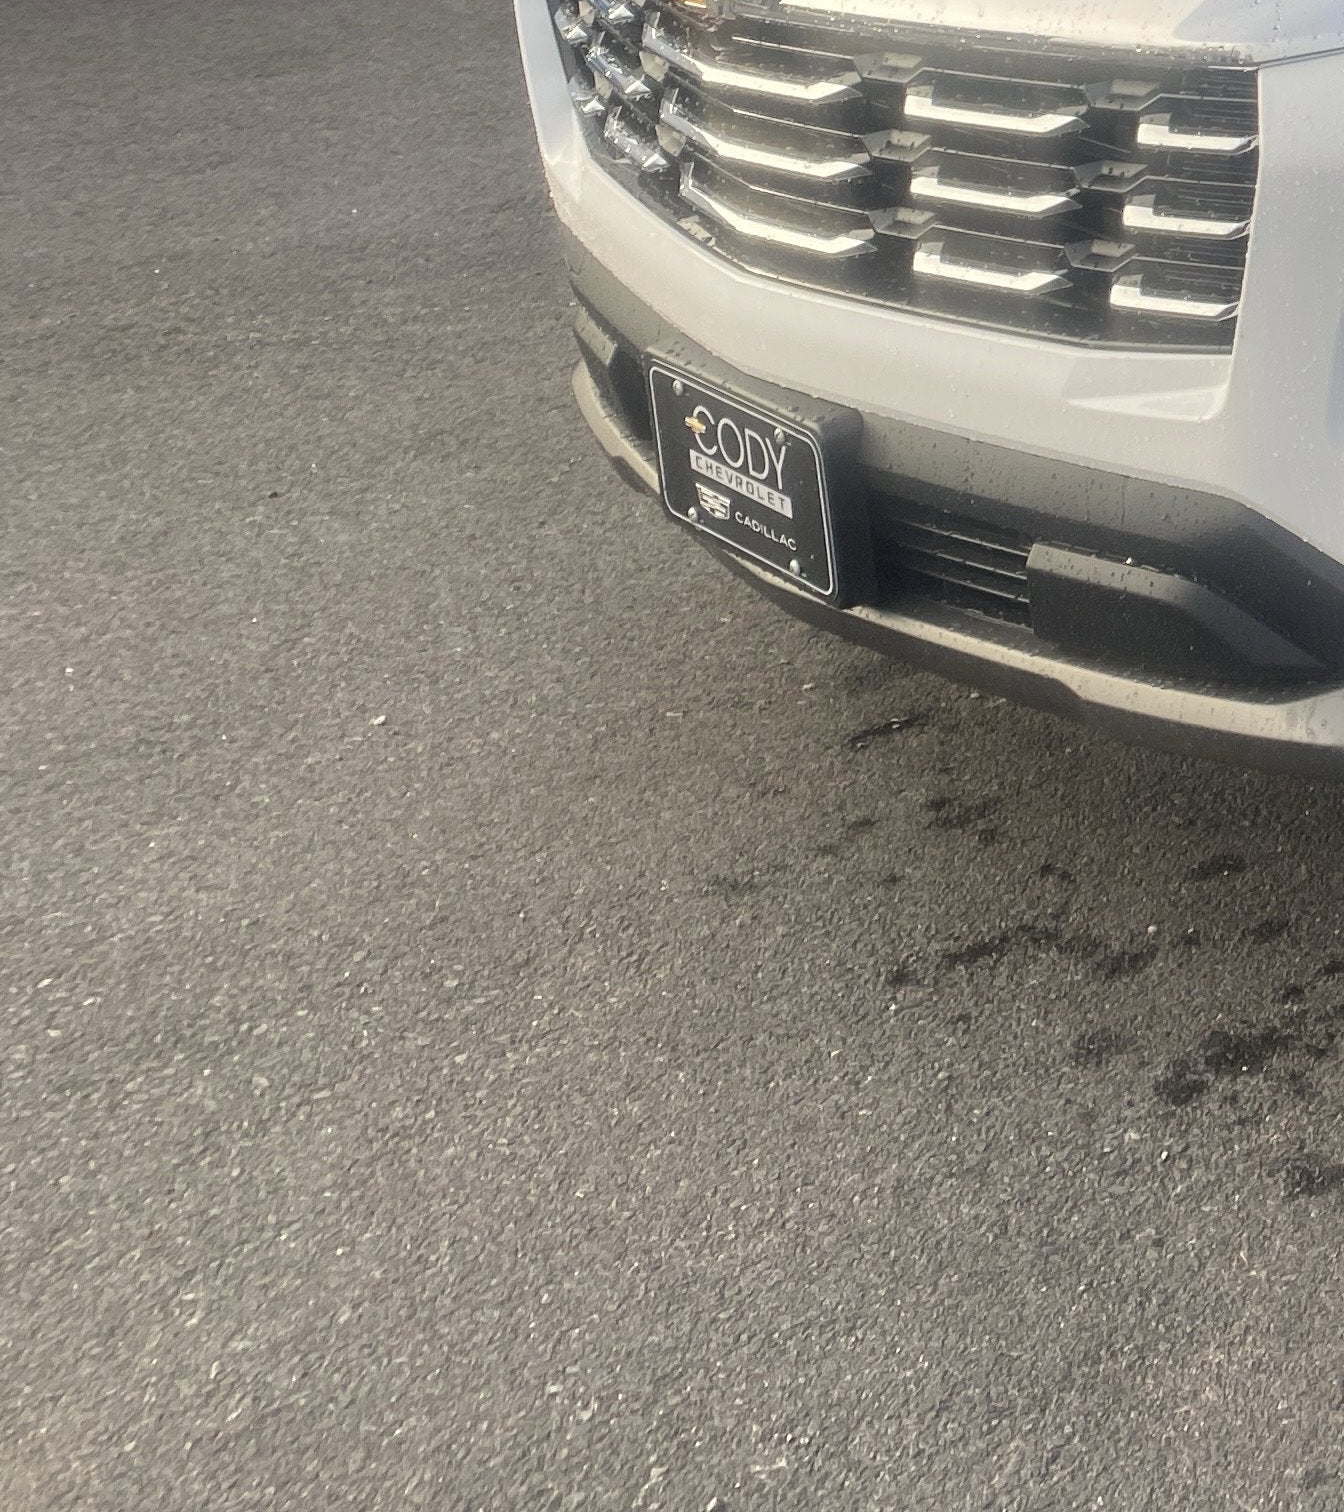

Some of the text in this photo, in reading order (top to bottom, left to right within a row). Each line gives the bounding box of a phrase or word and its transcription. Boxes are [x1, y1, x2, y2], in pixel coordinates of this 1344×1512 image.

[692, 405, 786, 490] CODY
[695, 455, 786, 512] CHEVROLET
[735, 511, 797, 551] CADILLAC
